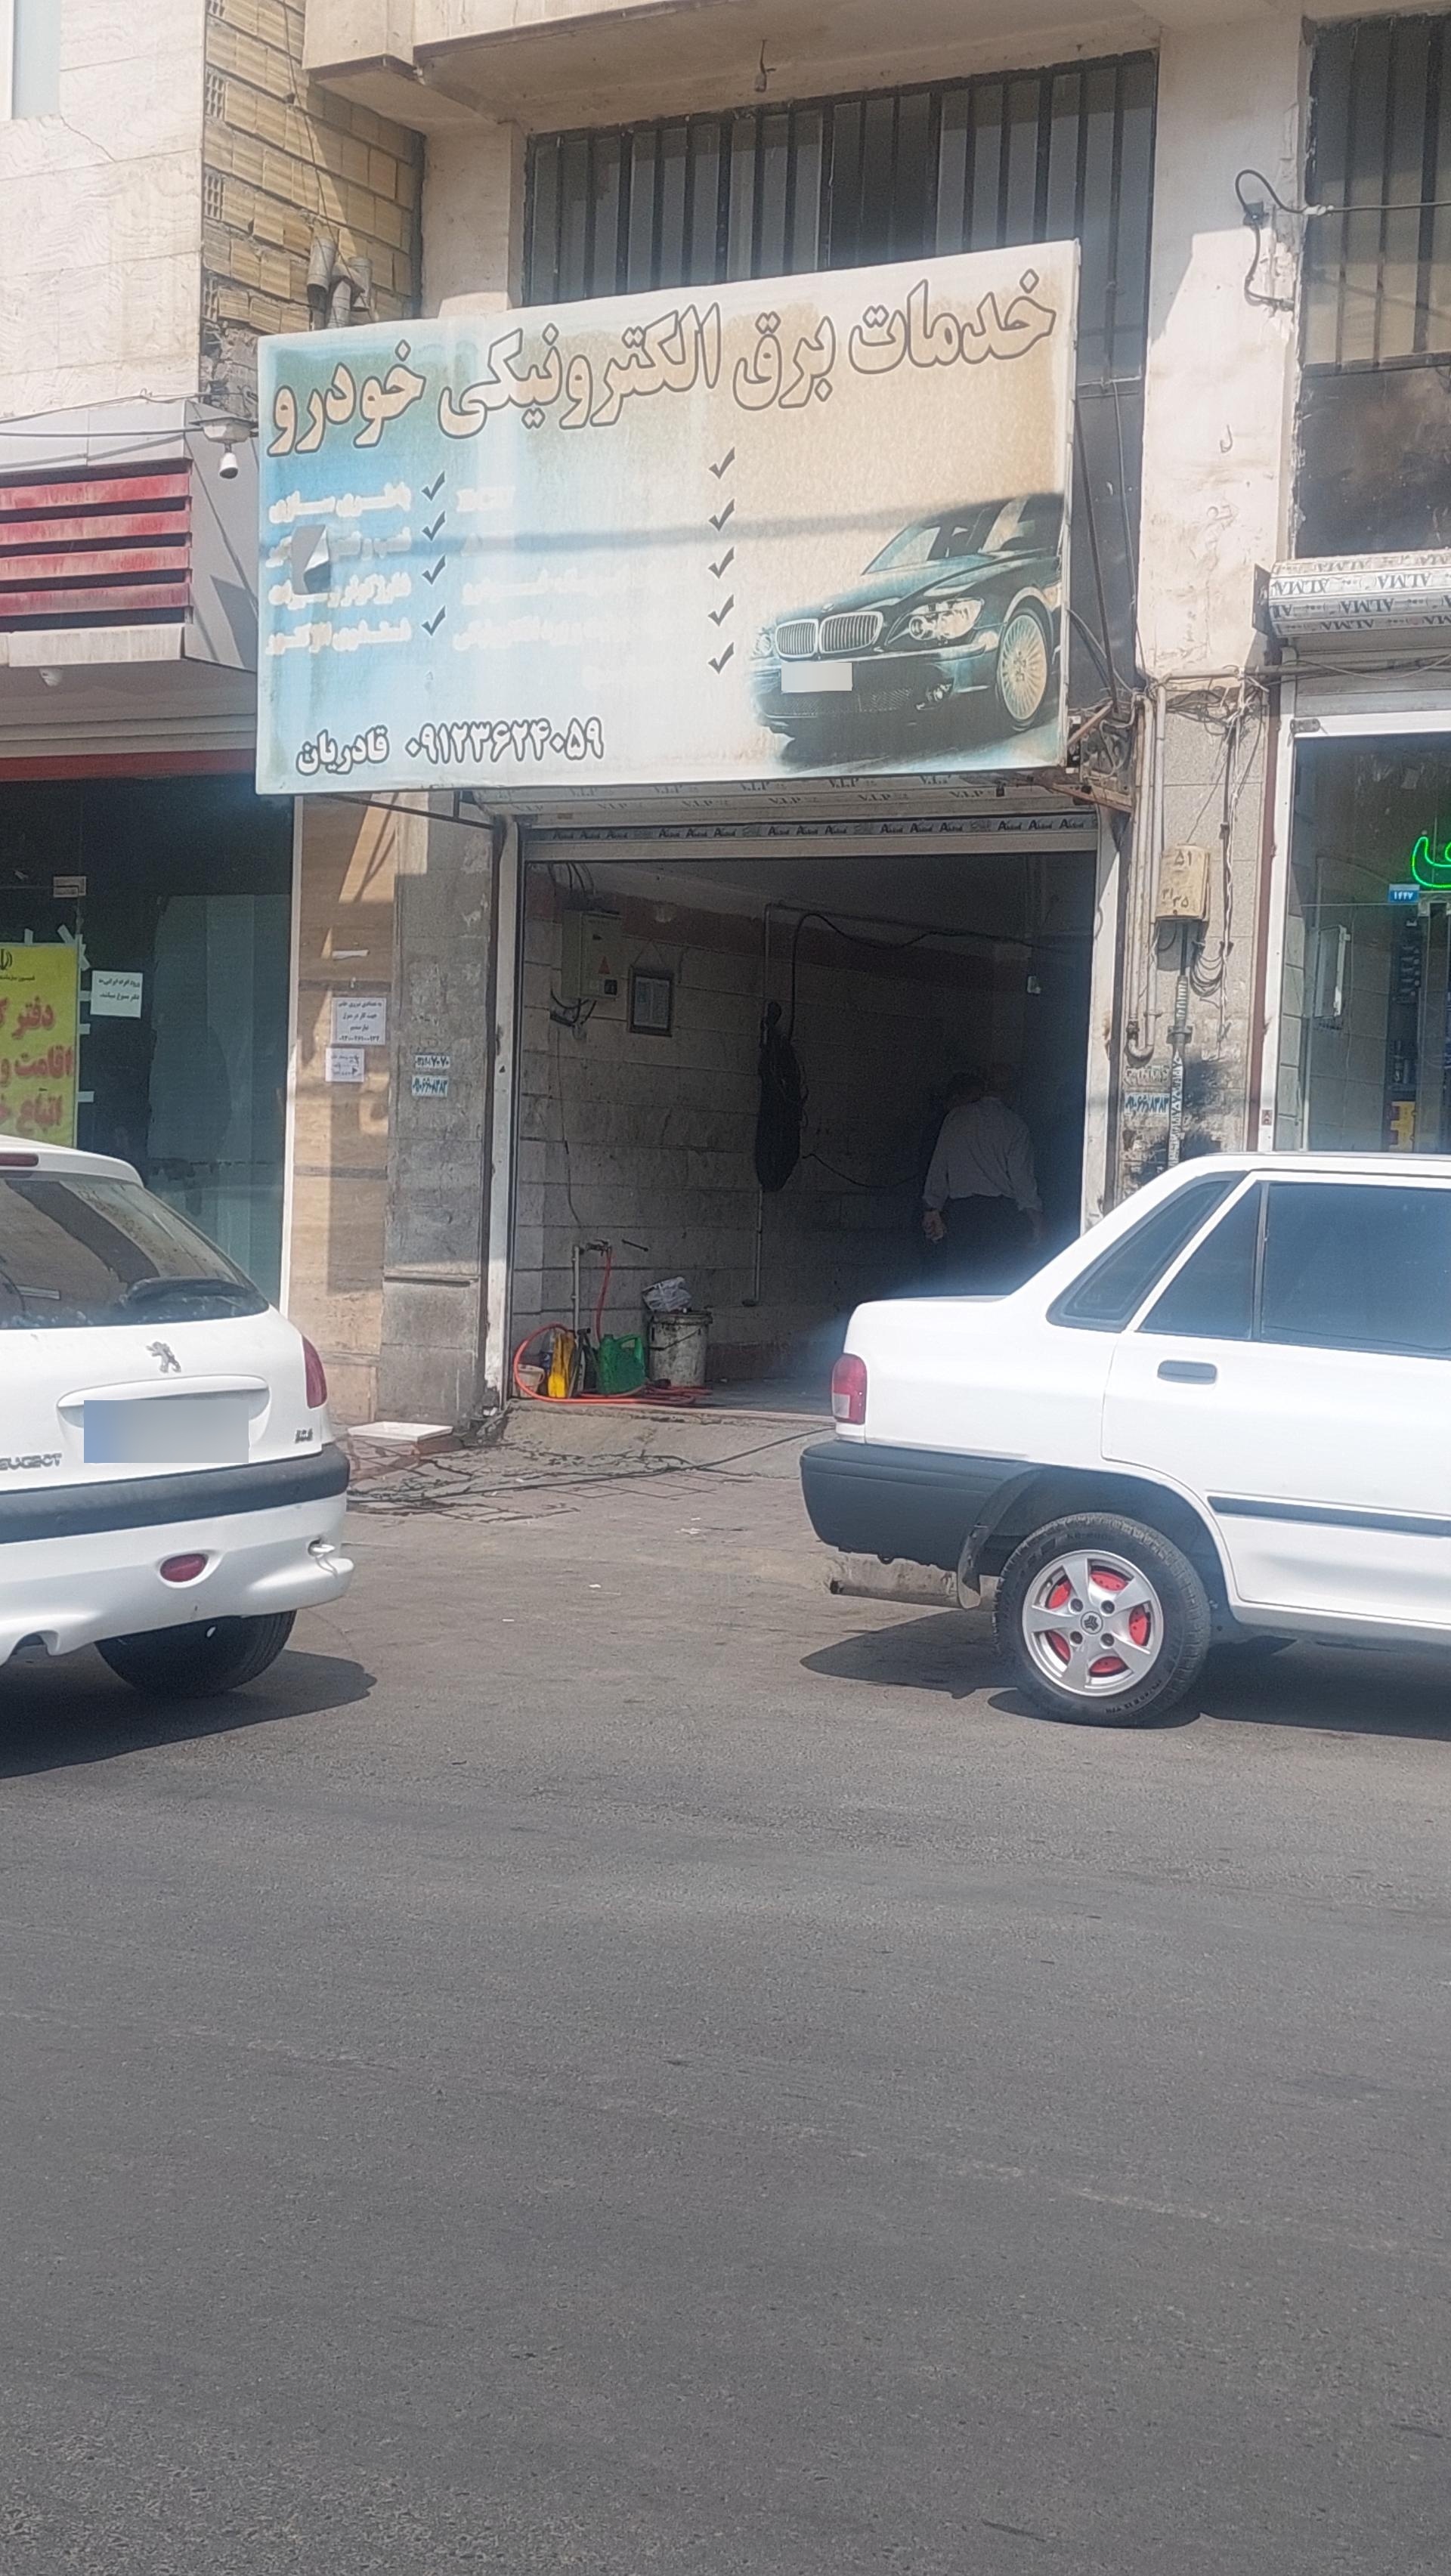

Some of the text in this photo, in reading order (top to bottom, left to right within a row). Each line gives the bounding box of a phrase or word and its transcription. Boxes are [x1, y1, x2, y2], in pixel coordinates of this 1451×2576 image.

[268, 268, 1057, 456] خدمات برق الکترونیکی خودرو
[1377, 572, 1431, 589] ALMA
[1340, 598, 1394, 613] ALMA
[1321, 619, 1374, 630] ALMA
[295, 716, 604, 777] ۰۹۱۲۳۶۲۴۰۵۹ قادریان
[949, 790, 984, 799] V.I.P
[11, 995, 55, 1040] دفتر
[14, 1044, 73, 1079] اقامت
